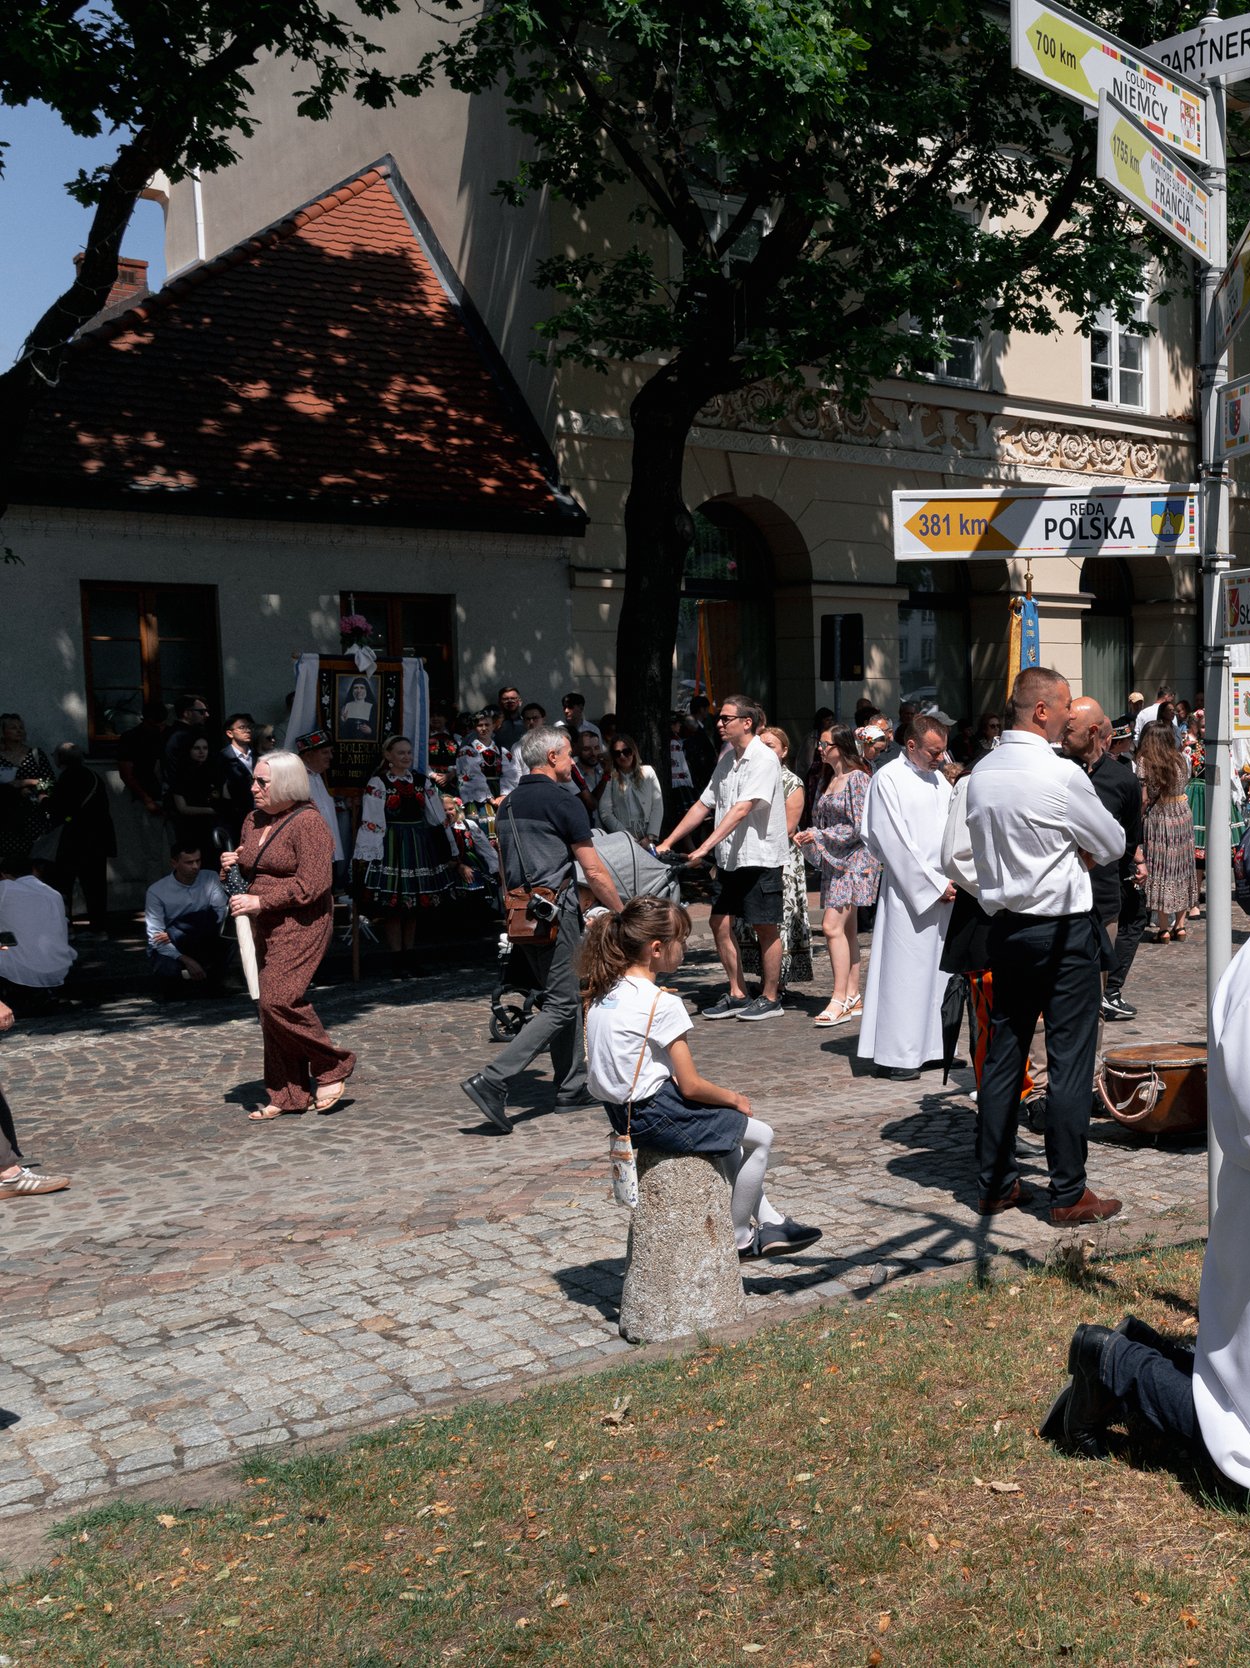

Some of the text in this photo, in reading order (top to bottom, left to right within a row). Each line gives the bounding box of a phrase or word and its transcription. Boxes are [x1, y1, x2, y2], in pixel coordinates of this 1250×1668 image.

[1035, 29, 1077, 71] 700 km
[1125, 69, 1157, 97] COLDITZ
[1112, 77, 1168, 125] NIEMCY
[1113, 134, 1140, 175] 1755 km
[1155, 178, 1191, 227] FRANCJA
[918, 513, 989, 537] 381 km
[1069, 502, 1105, 516] REDA
[1044, 516, 1135, 541] POLSKA
